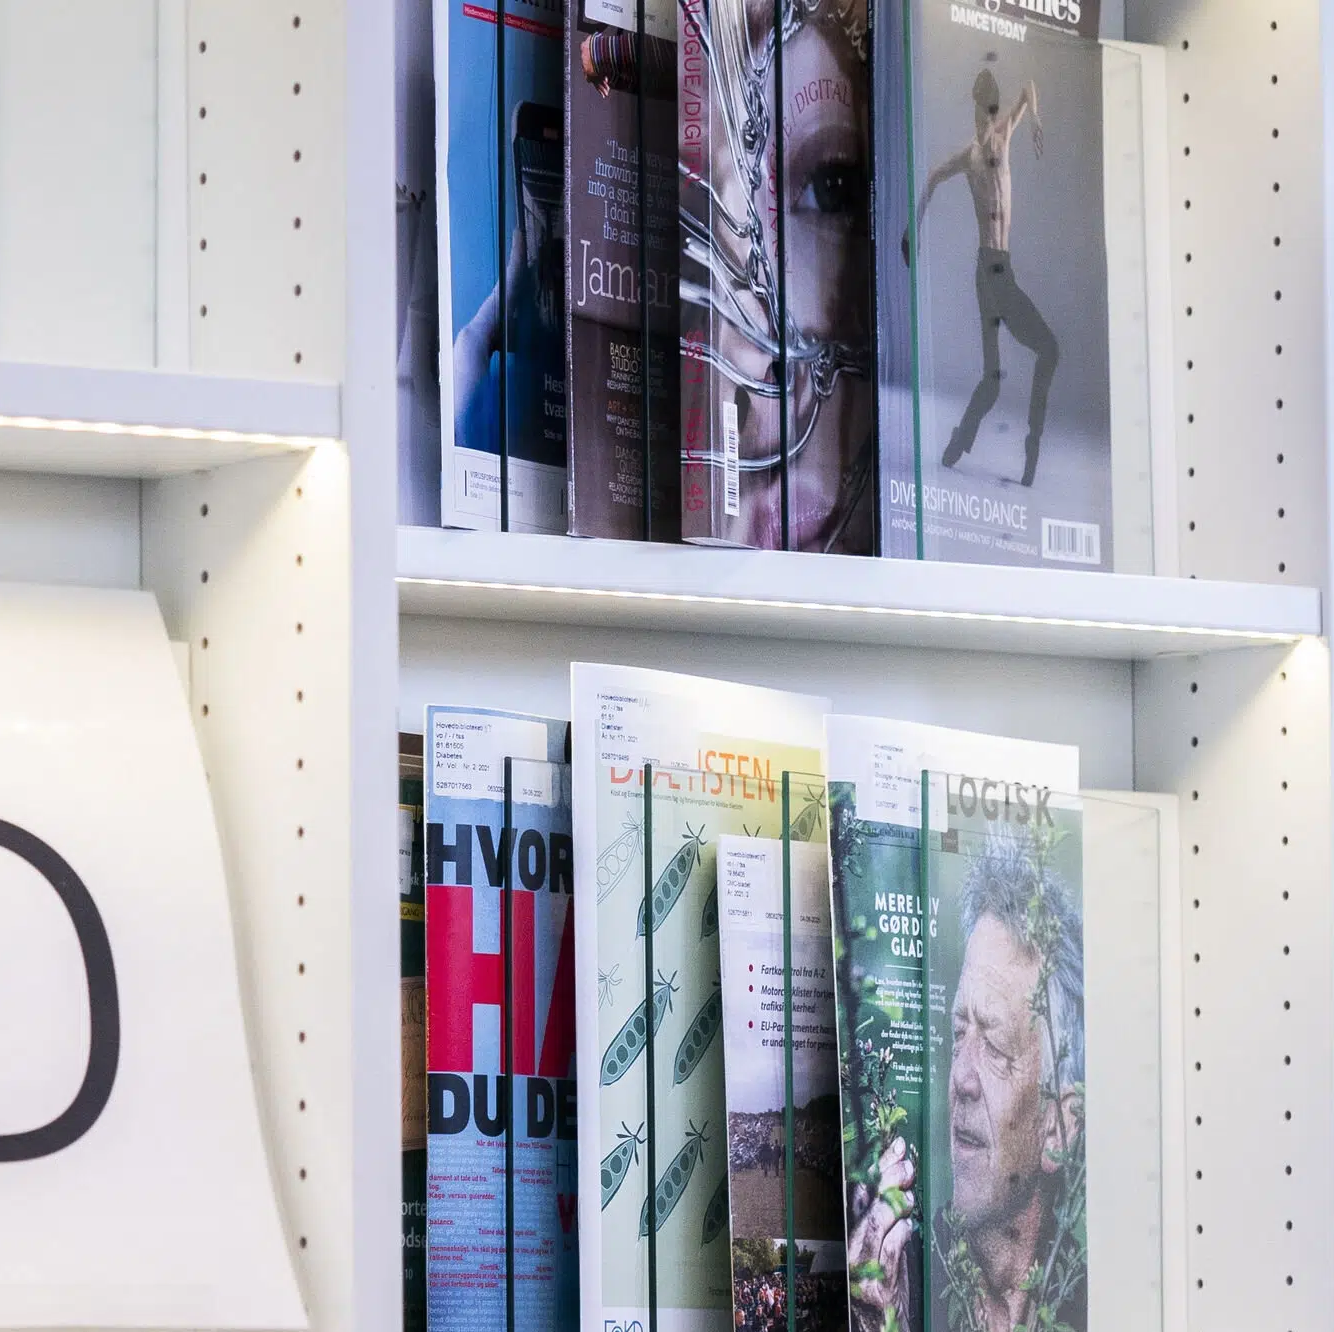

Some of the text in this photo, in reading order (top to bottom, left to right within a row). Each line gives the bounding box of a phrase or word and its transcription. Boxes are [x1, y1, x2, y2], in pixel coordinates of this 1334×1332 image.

[794, 78, 852, 115] DIGITAL
[588, 176, 607, 197] into
[609, 187, 615, 200] a
[604, 221, 618, 241] the
[610, 341, 631, 359] BACK
[611, 356, 639, 373] STUDIO
[890, 479, 1028, 530] DIVERSIFYING DANCE
[946, 776, 1056, 828] LOGISK
[426, 822, 574, 905] HVOR
[875, 892, 913, 914] MERE
[879, 914, 909, 936] GØR
[891, 937, 923, 958] GLAD
[813, 968, 826, 979] A-Z
[761, 985, 812, 998] Motorcklister
[761, 1001, 816, 1013] trafiksikerhed
[761, 1021, 819, 1034] EU-Paramentet
[428, 1072, 508, 1138] DU
